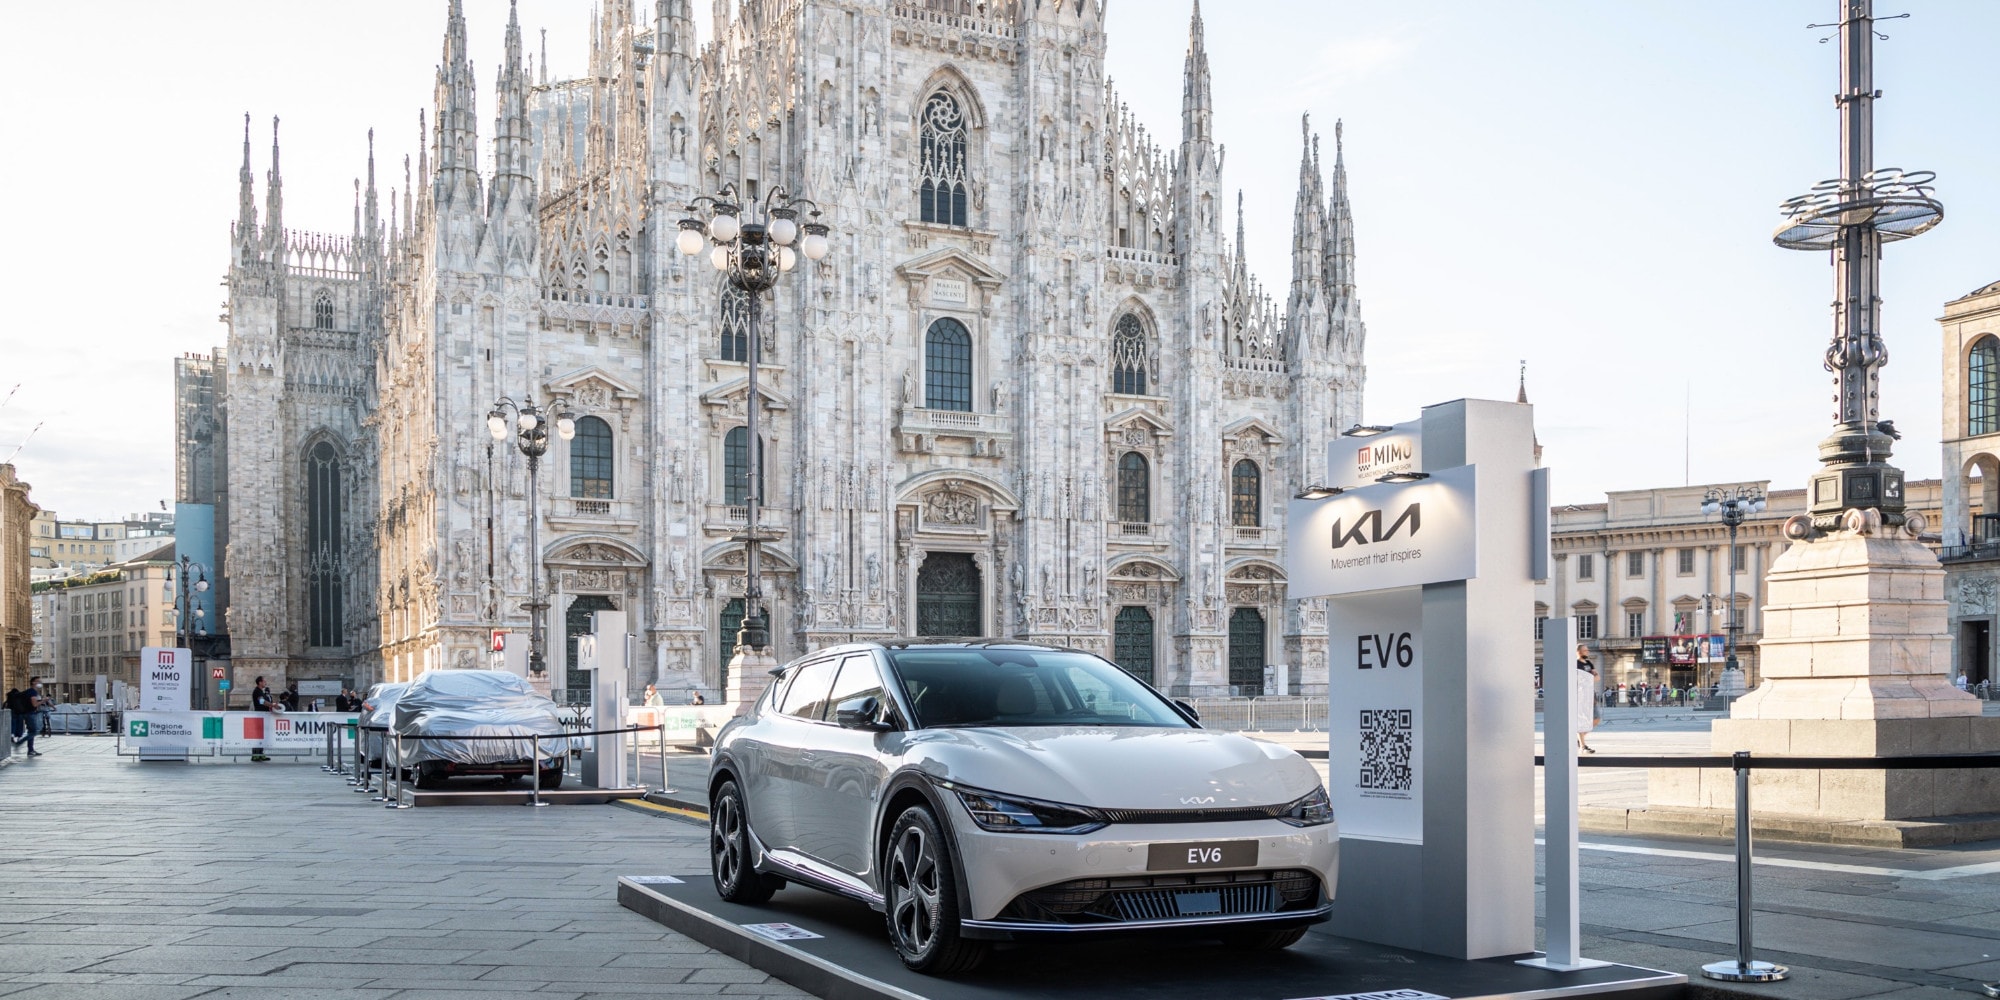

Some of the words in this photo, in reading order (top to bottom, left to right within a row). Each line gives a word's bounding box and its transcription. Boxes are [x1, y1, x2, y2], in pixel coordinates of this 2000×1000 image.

[1374, 440, 1412, 466] MIMO
[1332, 502, 1420, 549] KIA
[1331, 555, 1371, 570] Movement
[1373, 553, 1389, 564] that
[1391, 548, 1422, 563] inspires
[1358, 632, 1413, 669] EV6
[152, 672, 180, 681] MIMO
[213, 670, 223, 678] M
[1180, 796, 1215, 804] KIA
[1188, 848, 1221, 863] EV6
